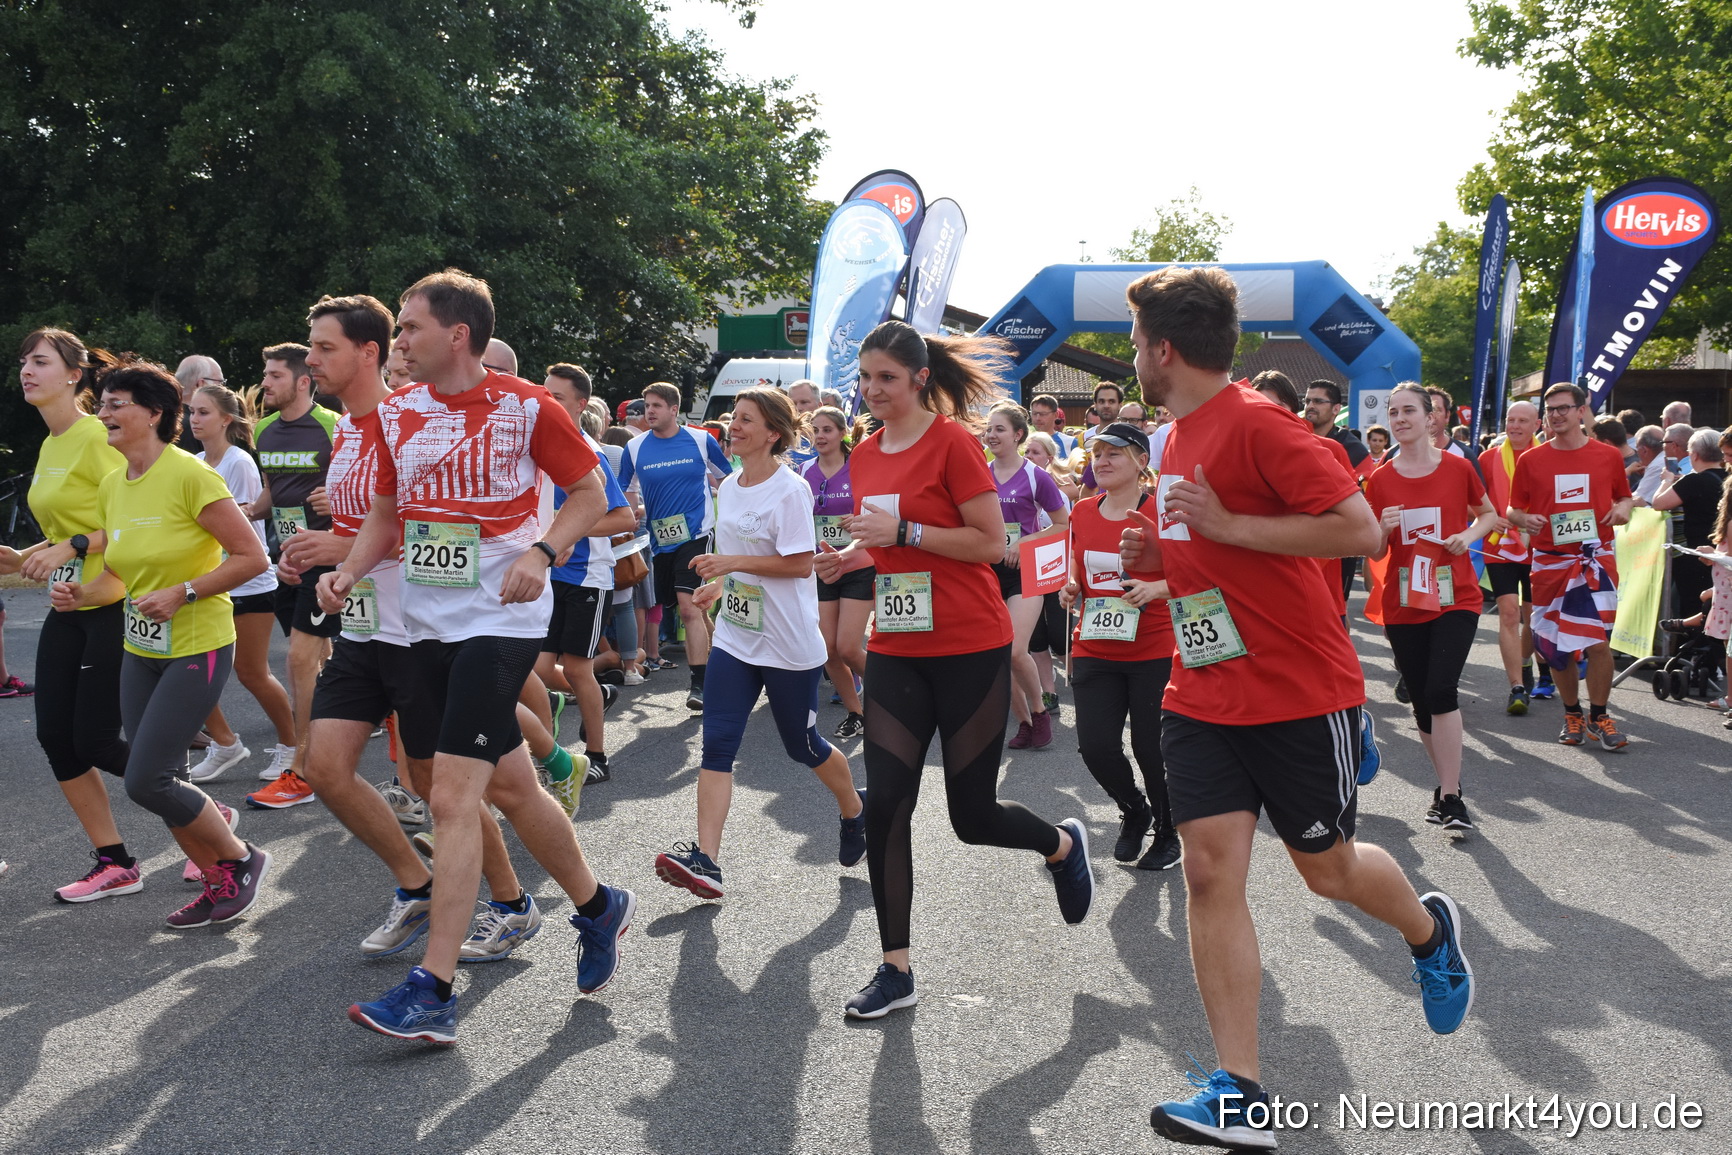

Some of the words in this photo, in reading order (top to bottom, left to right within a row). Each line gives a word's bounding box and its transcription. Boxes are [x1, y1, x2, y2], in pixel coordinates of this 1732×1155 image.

[1614, 205, 1701, 236] Hervis
[1624, 231, 1659, 239] SPORTS
[924, 218, 952, 293] Fischer
[935, 226, 956, 289] AUTOMOBILE
[1003, 325, 1047, 335] Fischer
[721, 378, 756, 386] abavent
[260, 453, 316, 466] BOCK
[643, 458, 694, 471] energiegeladen
[278, 521, 298, 535] 298
[657, 524, 683, 539] 2151
[822, 526, 843, 538] 897
[1556, 520, 1591, 537] 2445
[411, 543, 468, 569] 2205
[414, 566, 442, 575] Bleisteiner
[1036, 579, 1051, 588] DEHN
[341, 597, 366, 618] 21
[727, 593, 750, 617] 684
[884, 594, 916, 616] 503
[126, 612, 162, 640] 1202
[1092, 612, 1124, 628] 480
[1181, 618, 1219, 649] 553
[1205, 642, 1227, 653] Florian
[1302, 829, 1329, 839] adidas
